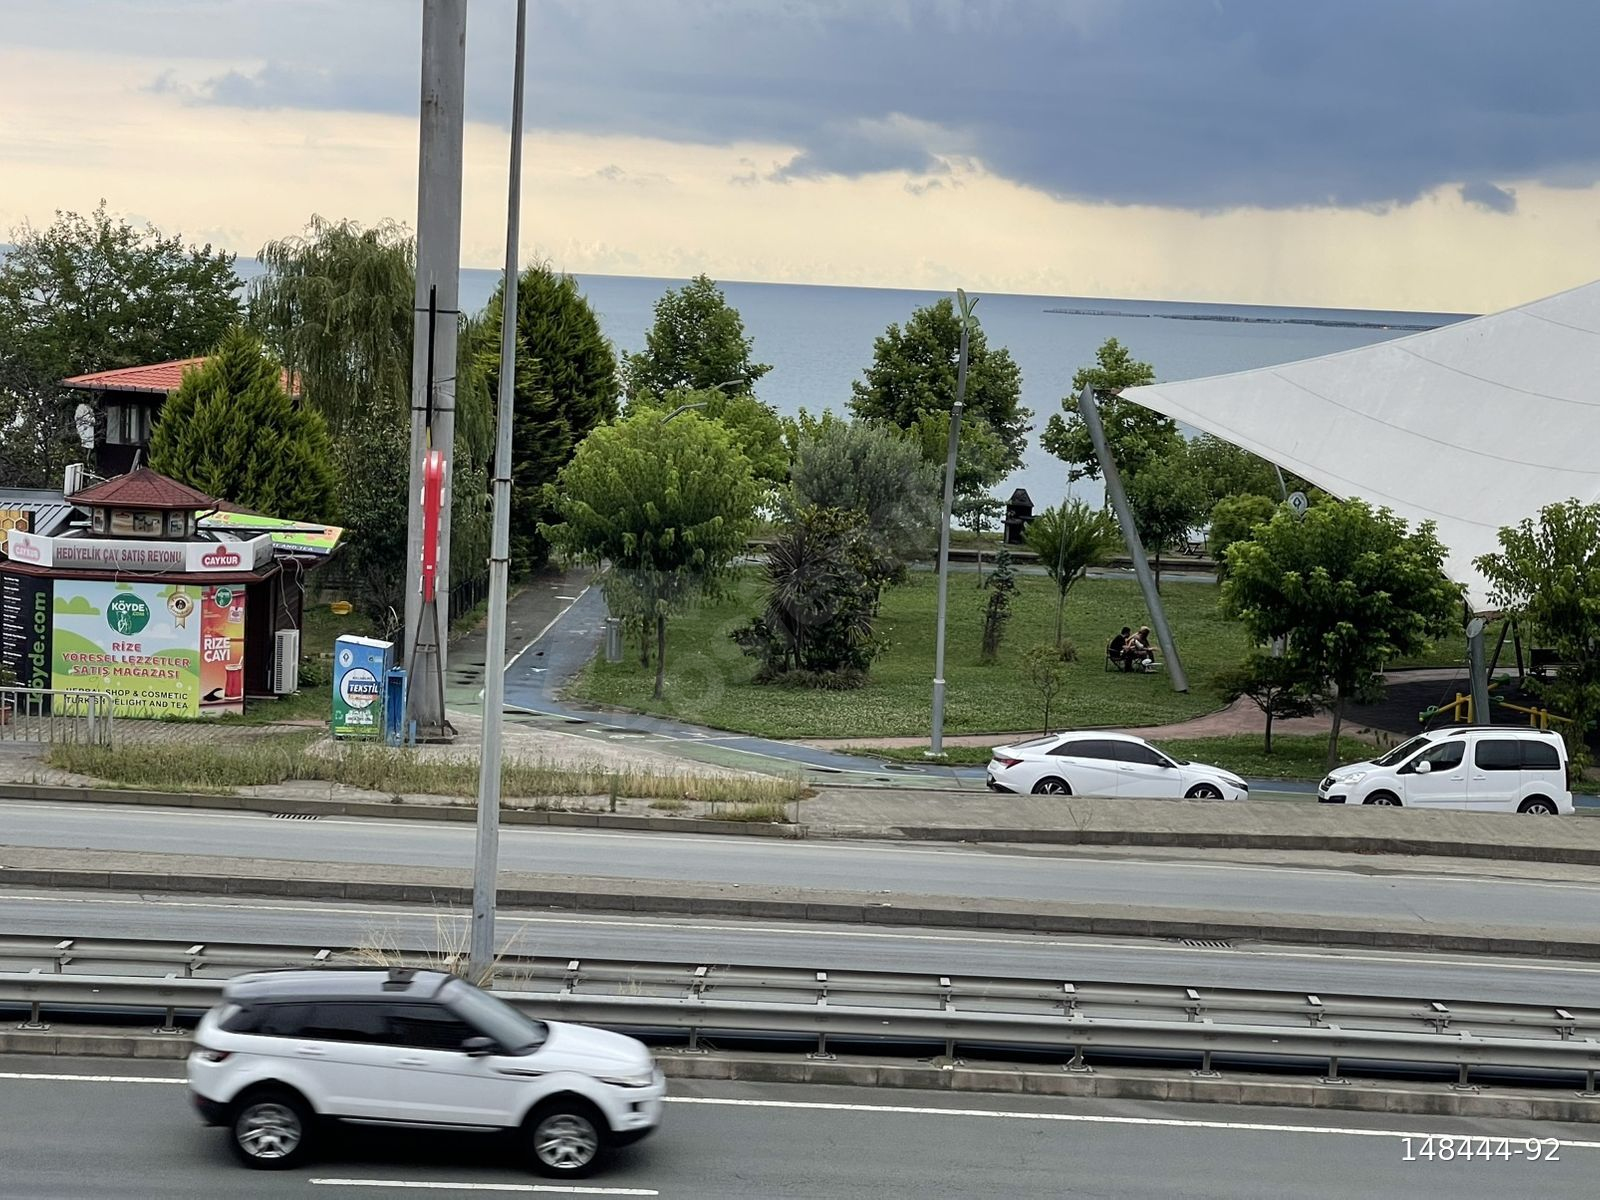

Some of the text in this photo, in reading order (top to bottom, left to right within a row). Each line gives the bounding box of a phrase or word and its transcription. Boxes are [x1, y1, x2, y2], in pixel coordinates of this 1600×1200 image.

[56, 545, 182, 565] HEDİYELİK ÇAY SATIŞ REYONU
[111, 600, 145, 612] KÖYDE
[112, 641, 142, 652] RİZE
[121, 655, 190, 668] LEZZETLER
[73, 665, 109, 677] SATIŞ
[105, 688, 130, 697] SHOP
[142, 690, 188, 700] COSMETIC
[66, 696, 188, 709] TURKSH ELIGHT AND TEA
